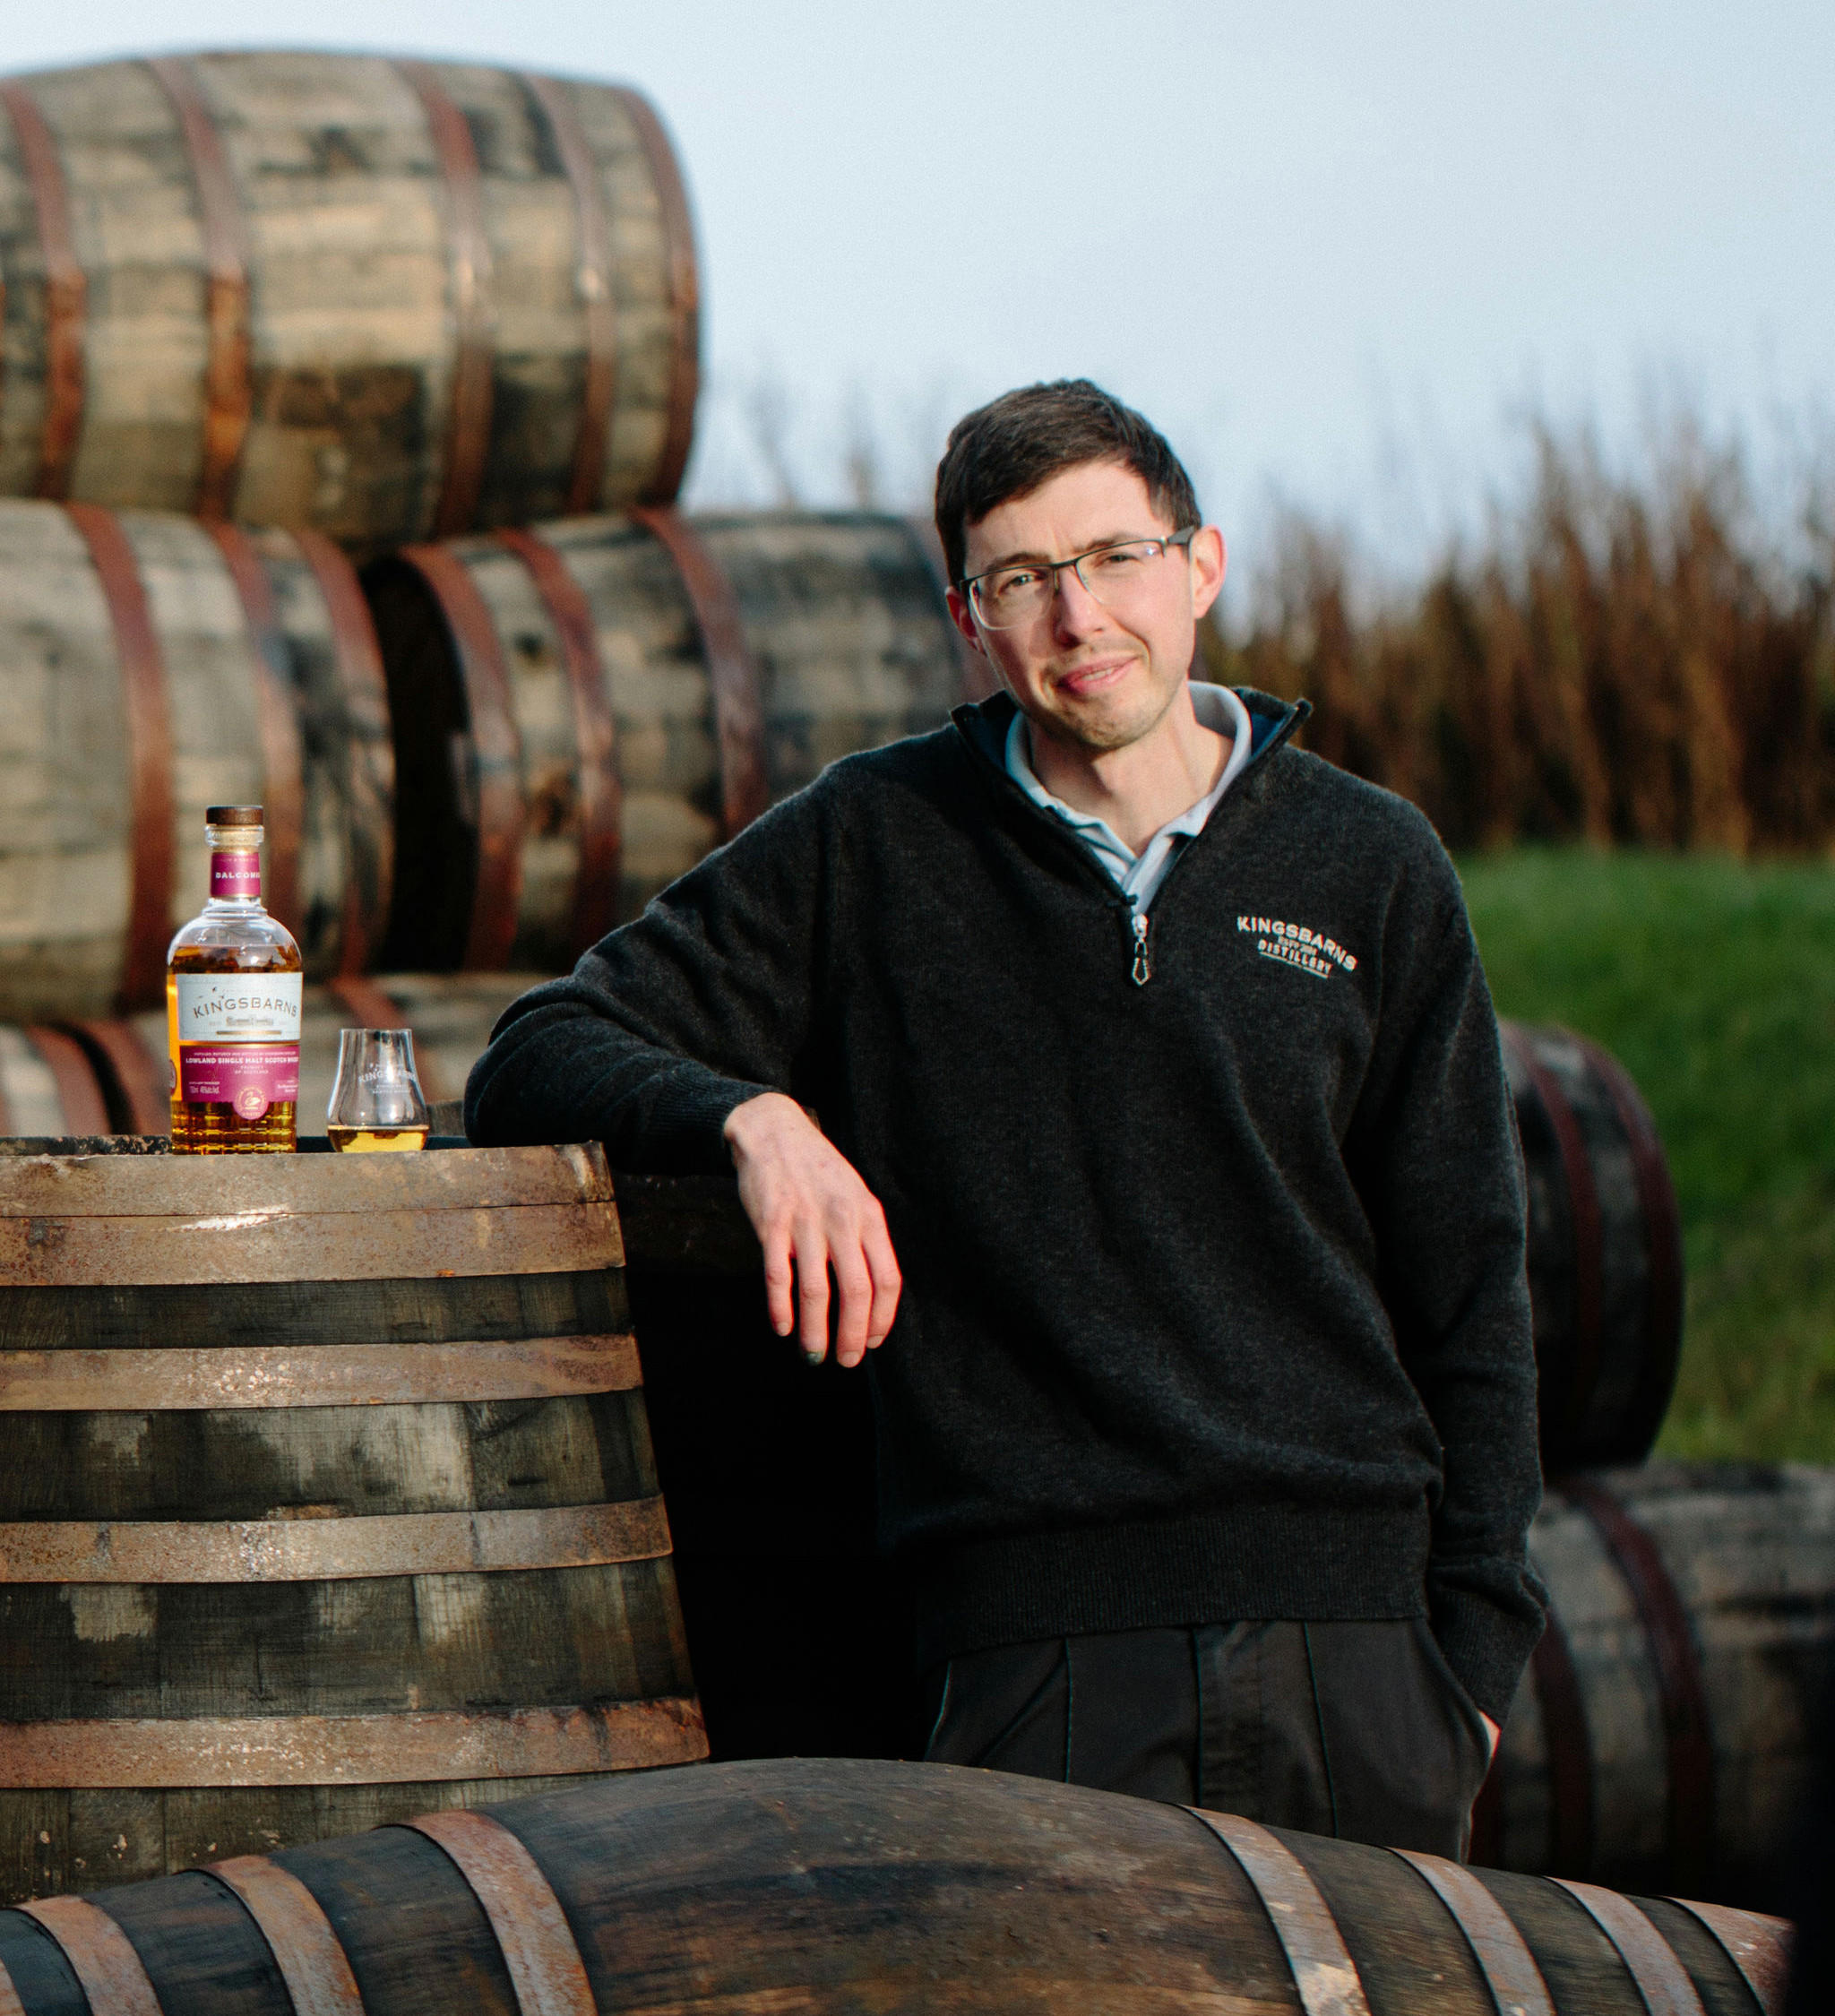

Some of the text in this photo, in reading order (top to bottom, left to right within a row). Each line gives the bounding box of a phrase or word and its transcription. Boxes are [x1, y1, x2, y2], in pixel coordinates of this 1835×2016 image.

[1236, 916, 1358, 972] KINGSBARNS
[1257, 938, 1333, 975] DISTILLERY
[193, 996, 297, 1019] KINGSBARNS
